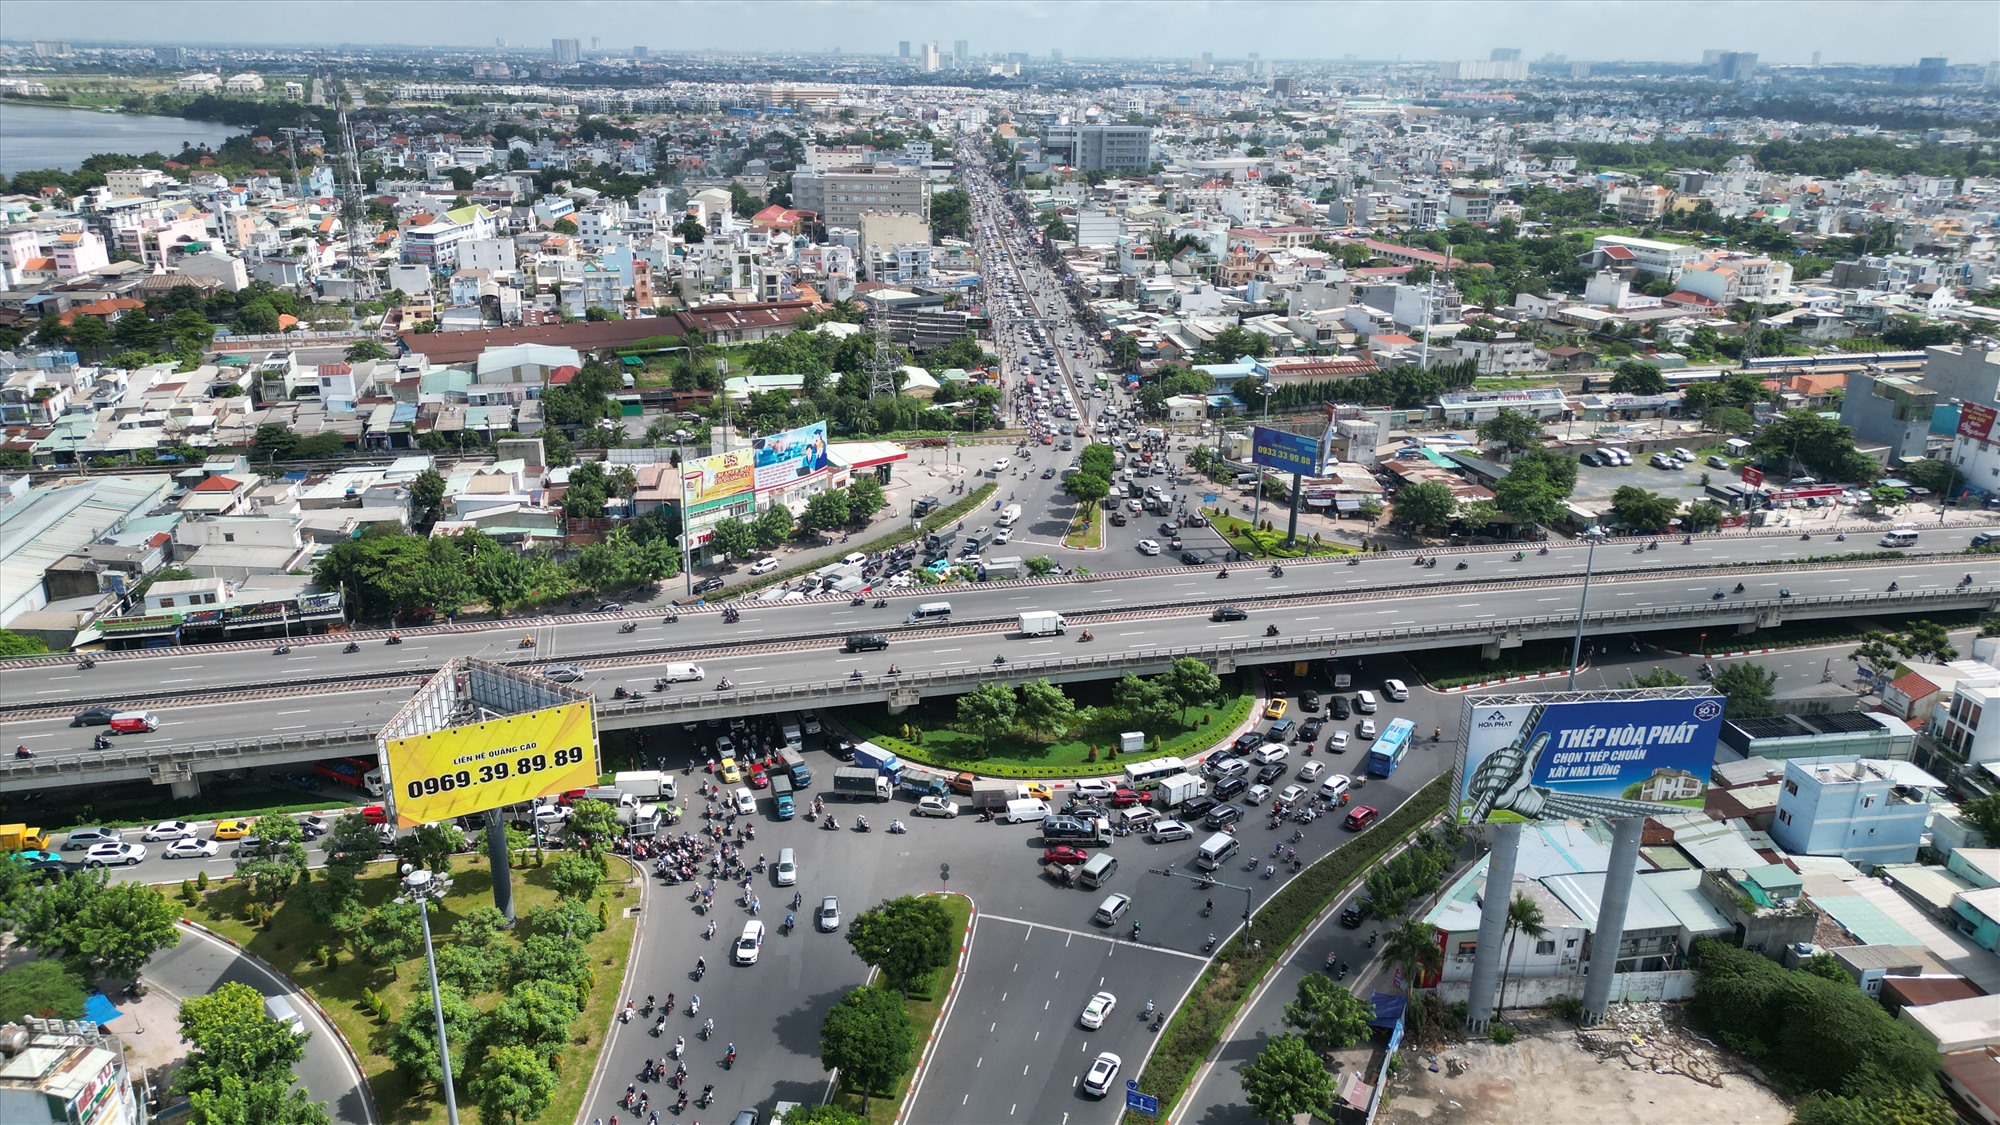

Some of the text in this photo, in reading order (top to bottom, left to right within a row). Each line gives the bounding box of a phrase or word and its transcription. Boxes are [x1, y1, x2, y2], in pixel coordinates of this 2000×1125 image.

[1559, 721, 1699, 749] THÉP HÒA PHÁT
[453, 742, 537, 765] LIÊN HỆ QUẢNG CÁO
[1552, 745, 1647, 766] CHỌN THÉP CHUẨN
[407, 746, 583, 799] 0969.39.89.89
[1548, 763, 1621, 778] XÂY NHÀ VŨNG
